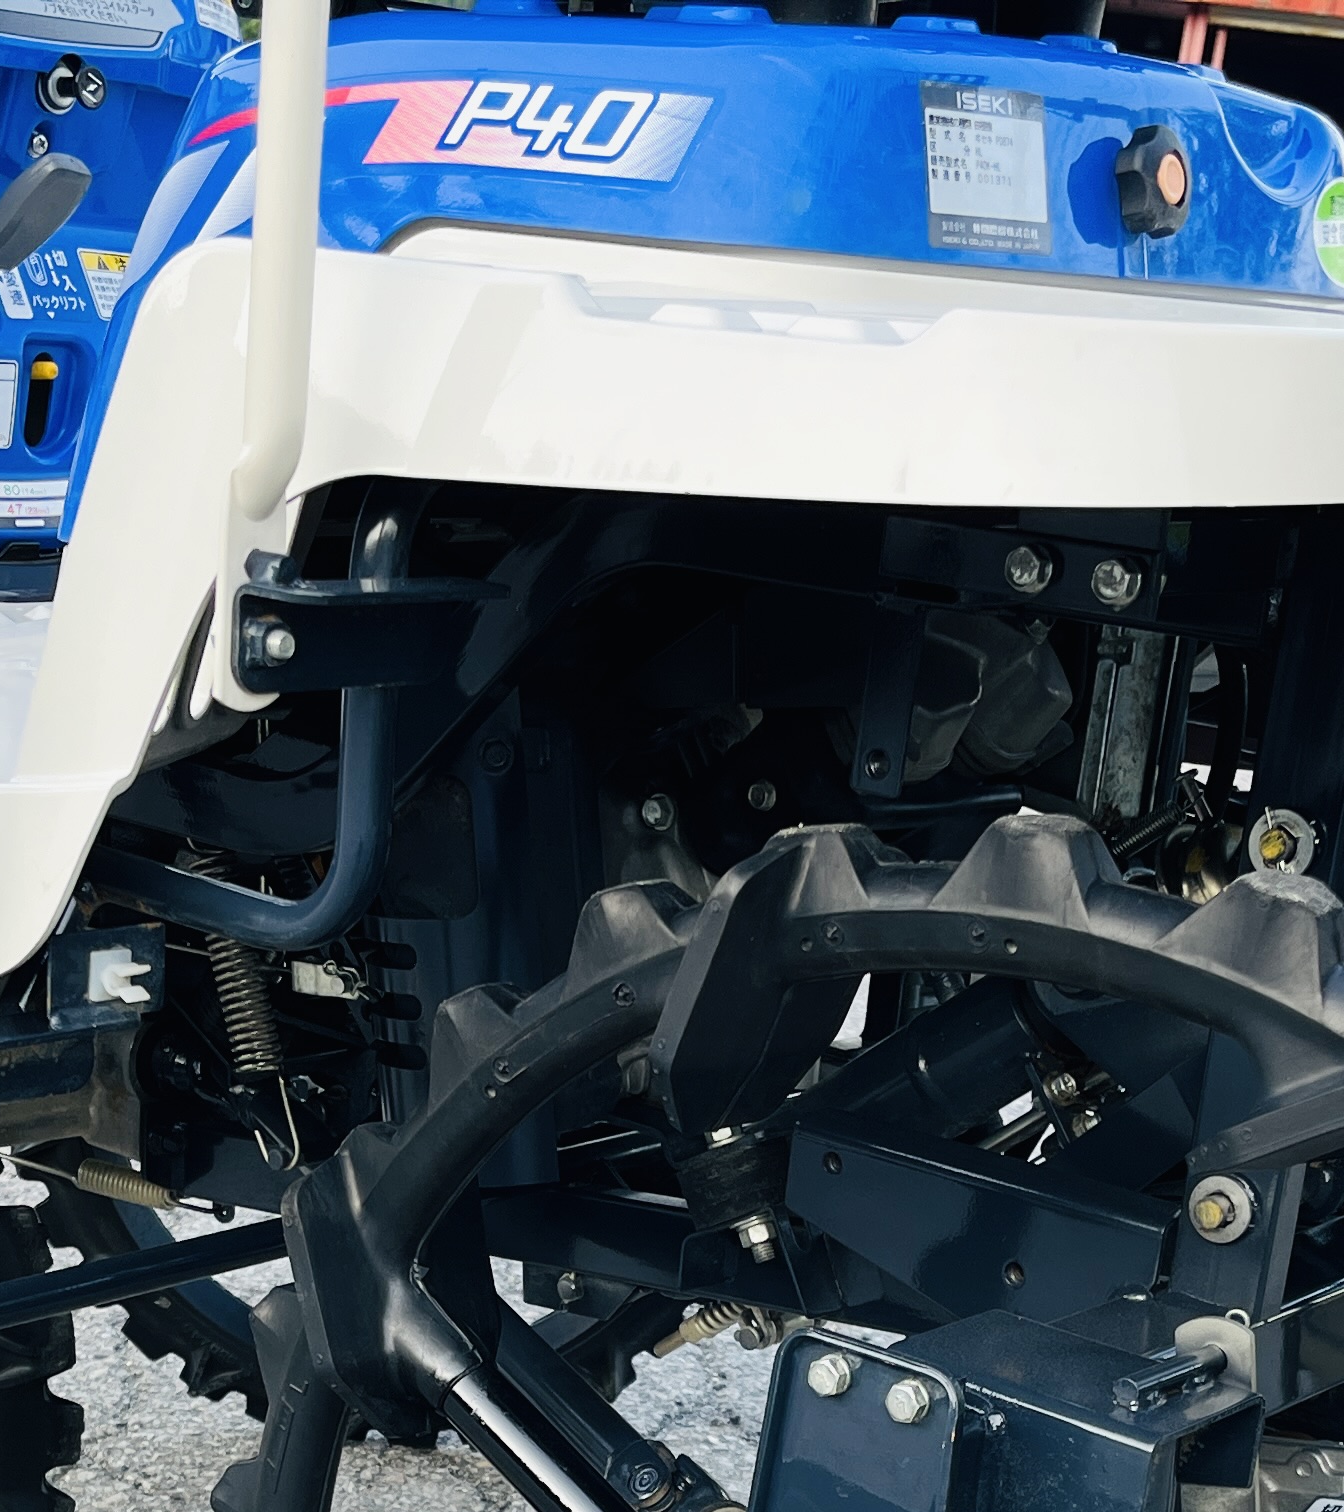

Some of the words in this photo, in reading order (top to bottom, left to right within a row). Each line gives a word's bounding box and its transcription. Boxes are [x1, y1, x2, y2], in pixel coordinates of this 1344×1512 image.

[956, 91, 1013, 115] ISEKI
[441, 79, 657, 160] P40
[62, 275, 77, 292] 入
[33, 295, 86, 312] バックリフト
[3, 484, 20, 496] 80
[7, 503, 23, 515] 47
